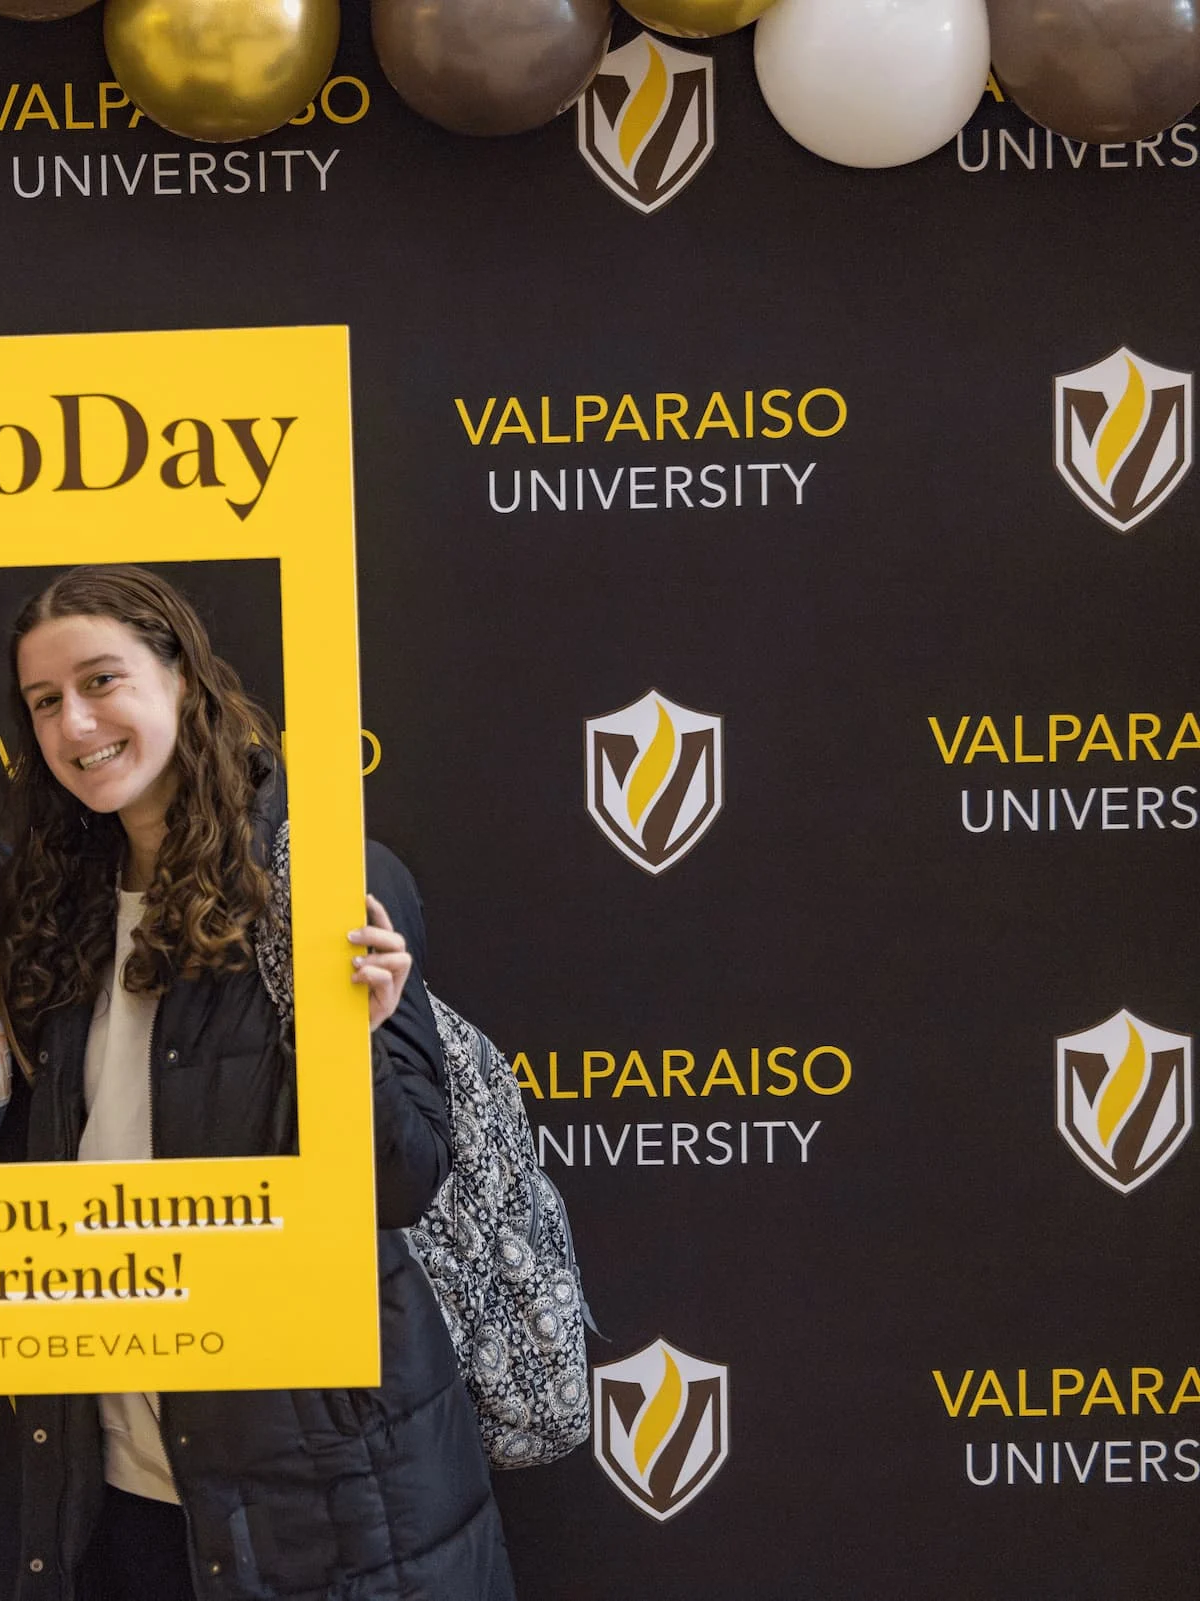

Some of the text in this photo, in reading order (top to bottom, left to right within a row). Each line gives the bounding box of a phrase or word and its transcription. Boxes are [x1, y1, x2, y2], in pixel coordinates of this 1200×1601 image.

[12, 149, 340, 199] UNIVERSITY
[454, 387, 848, 446] VALPARAISO
[488, 462, 817, 514] UNIVERSITY
[927, 712, 1200, 765] VALPARA
[961, 785, 1198, 833] UNIVERS
[510, 1045, 852, 1100] ALPARAISO
[538, 1120, 822, 1168] NIVERSITY
[82, 1181, 274, 1231] alumni
[931, 1366, 1200, 1418] VALPARA
[966, 1438, 1200, 1486] UNIVERS
